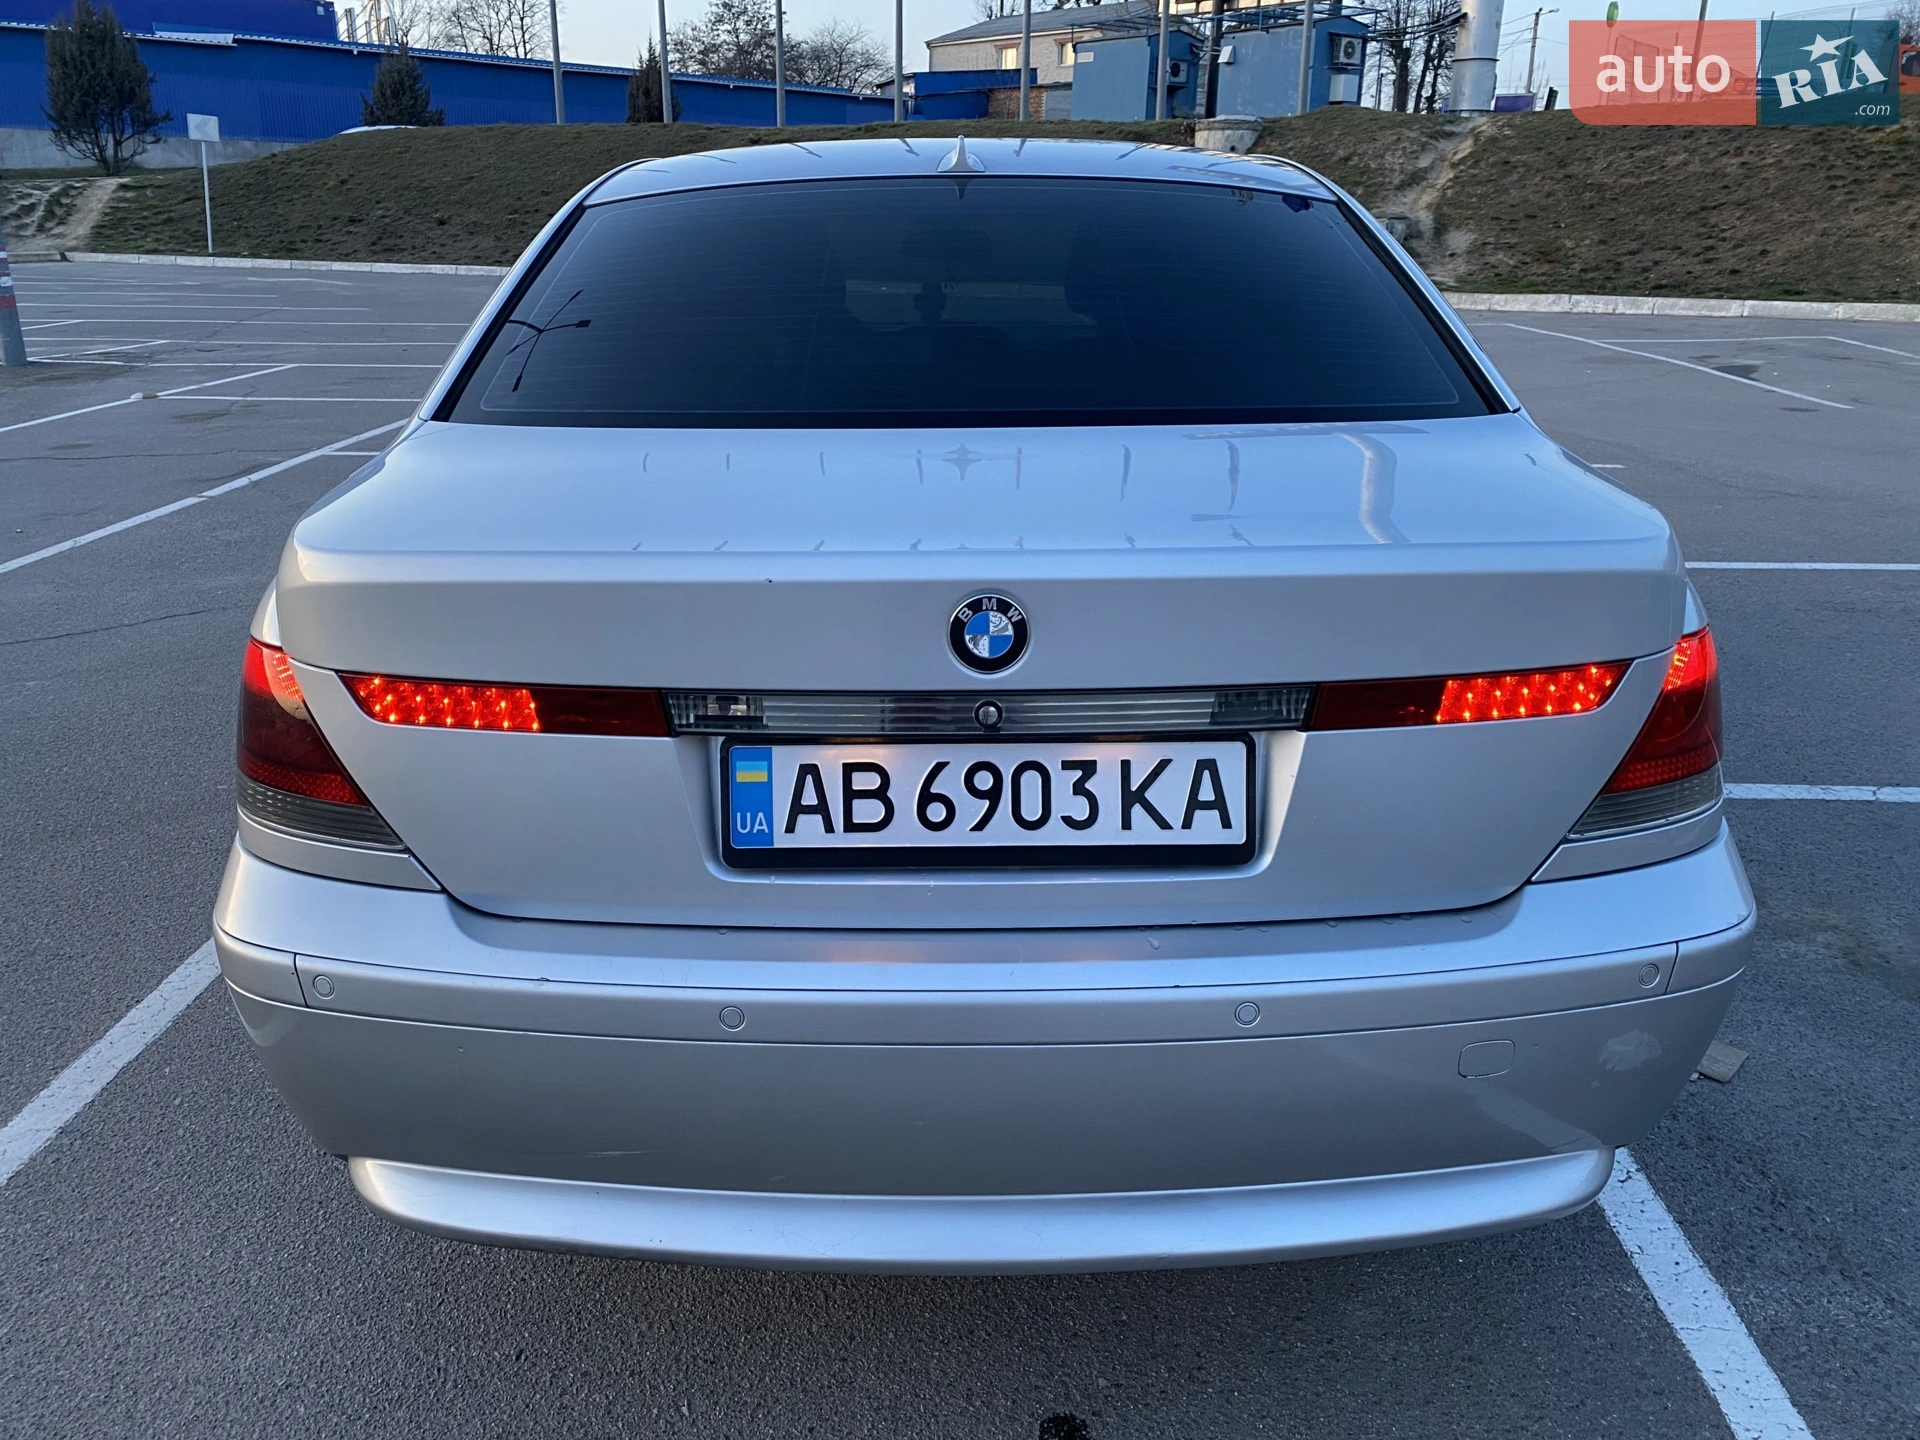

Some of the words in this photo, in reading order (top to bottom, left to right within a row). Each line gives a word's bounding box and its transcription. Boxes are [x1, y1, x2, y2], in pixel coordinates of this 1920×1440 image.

[957, 597, 1023, 623] BMW
[784, 761, 896, 834] AB
[916, 759, 1101, 832] 6903
[1120, 758, 1233, 831] KA
[736, 811, 770, 834] UA
